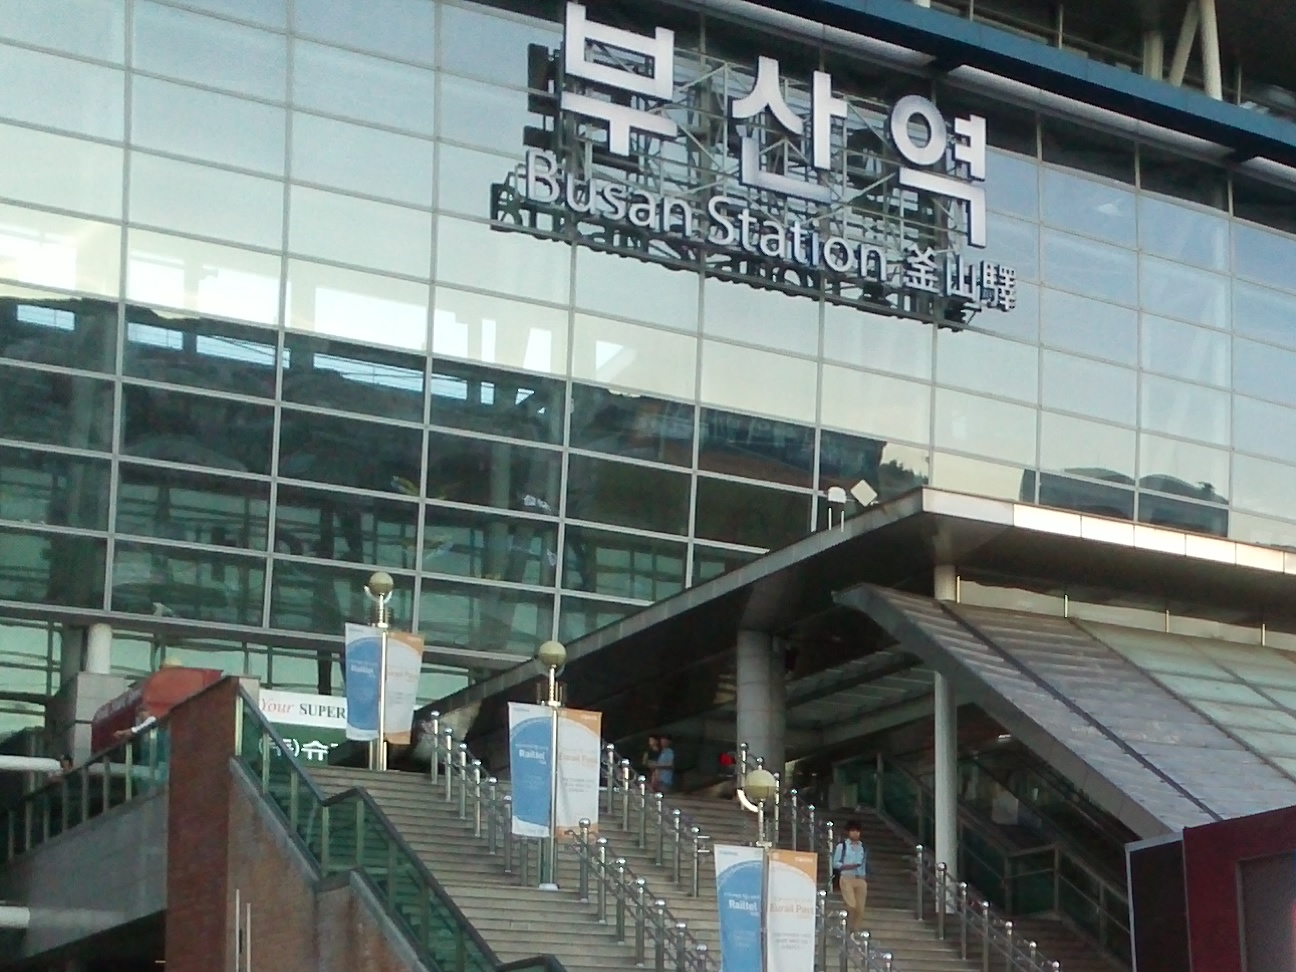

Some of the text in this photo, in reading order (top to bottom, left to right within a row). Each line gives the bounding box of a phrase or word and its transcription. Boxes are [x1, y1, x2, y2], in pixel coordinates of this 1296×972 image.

[561, 2, 987, 248] 부산역
[525, 150, 888, 282] Busan Station
[261, 697, 346, 719] Your SUPER
[728, 898, 758, 911] Railtel
